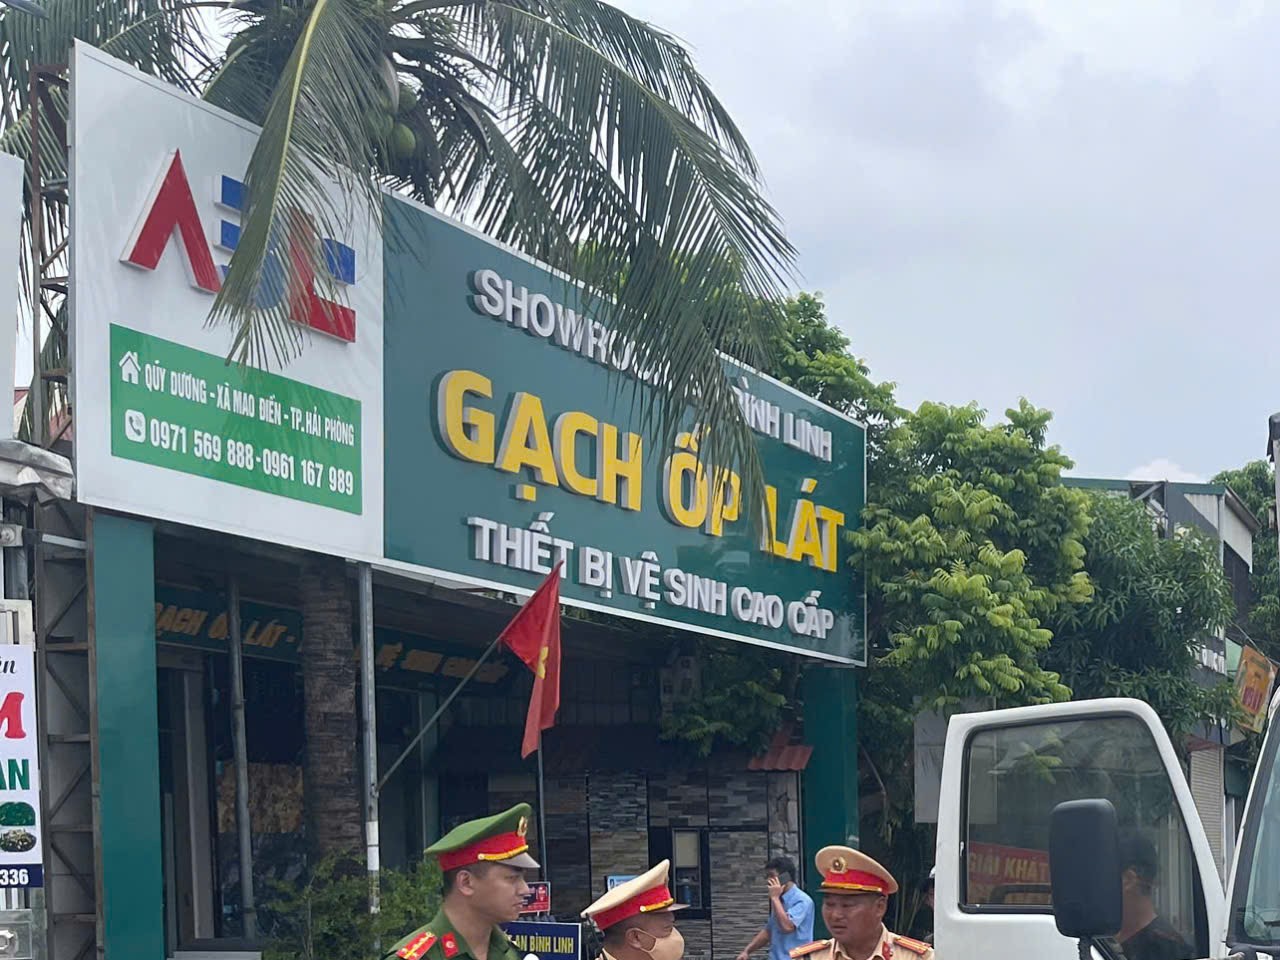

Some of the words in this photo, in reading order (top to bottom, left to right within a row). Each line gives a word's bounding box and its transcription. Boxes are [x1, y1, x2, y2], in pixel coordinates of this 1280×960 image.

[232, 389, 255, 418] MAO
[150, 417, 188, 455] 0971
[193, 430, 222, 463] 569
[301, 458, 324, 489] 167
[328, 466, 354, 496] 989
[783, 412, 832, 463] LINH
[437, 369, 644, 512] GẠCH
[760, 477, 845, 573] LÁT
[467, 511, 574, 579] THIẾT
[578, 546, 613, 599] BỊ
[618, 550, 662, 610] VỆ
[663, 568, 727, 617] SINH
[731, 586, 784, 629] CAO
[787, 590, 834, 639] CẤP
[553, 936, 574, 954] LINH
